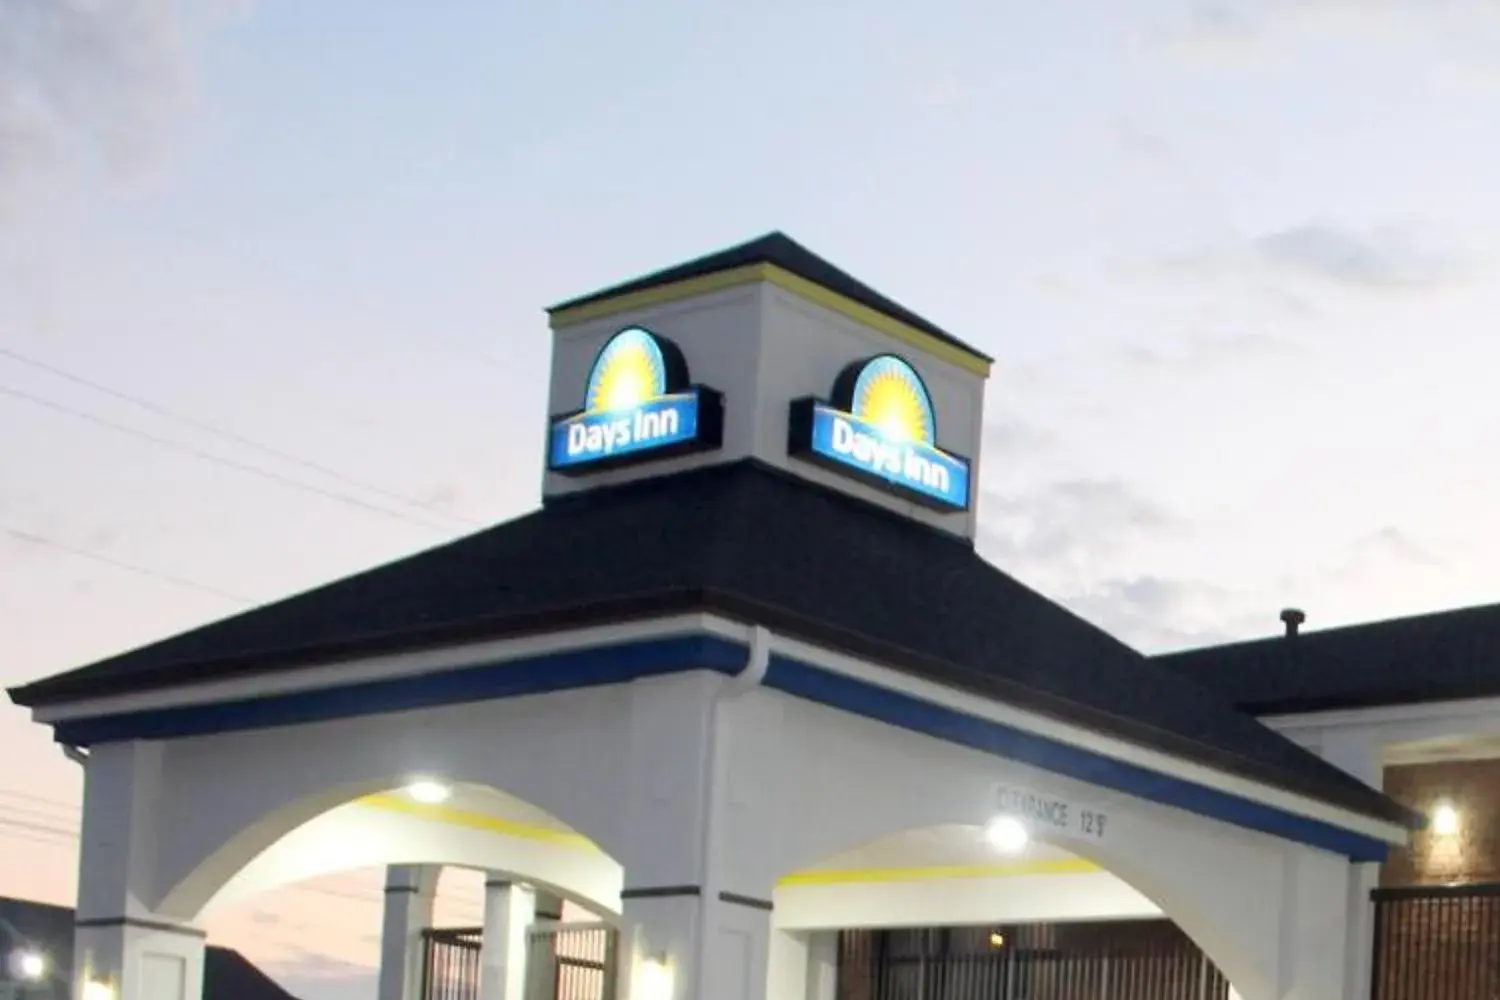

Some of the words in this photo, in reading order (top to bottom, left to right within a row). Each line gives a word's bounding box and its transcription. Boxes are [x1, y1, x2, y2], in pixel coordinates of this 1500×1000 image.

[567, 418, 631, 456] Days
[633, 408, 679, 442] Inn
[832, 417, 901, 474] Days
[902, 445, 949, 493] Inn
